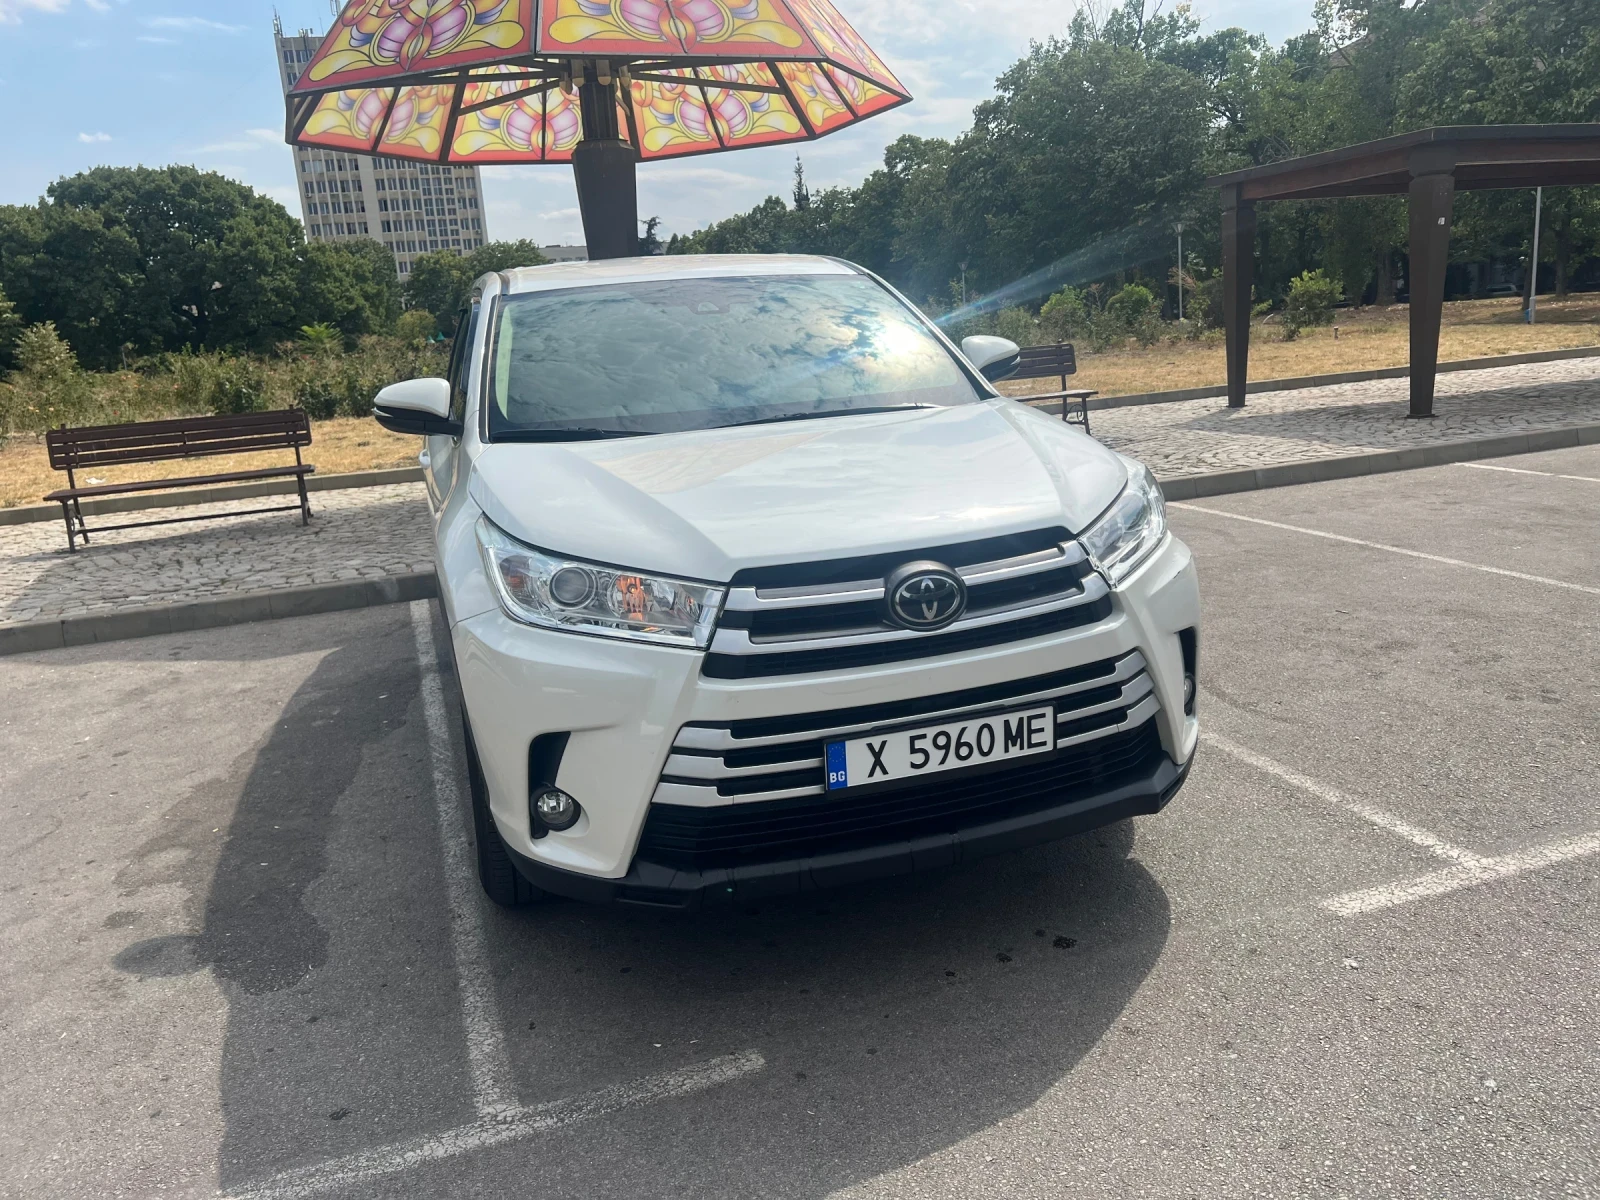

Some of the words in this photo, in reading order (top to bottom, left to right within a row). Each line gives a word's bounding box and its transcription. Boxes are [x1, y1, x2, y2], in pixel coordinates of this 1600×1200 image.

[866, 740, 889, 778] X
[909, 723, 995, 769] 5960
[1003, 713, 1047, 753] ME
[829, 770, 846, 783] BG
